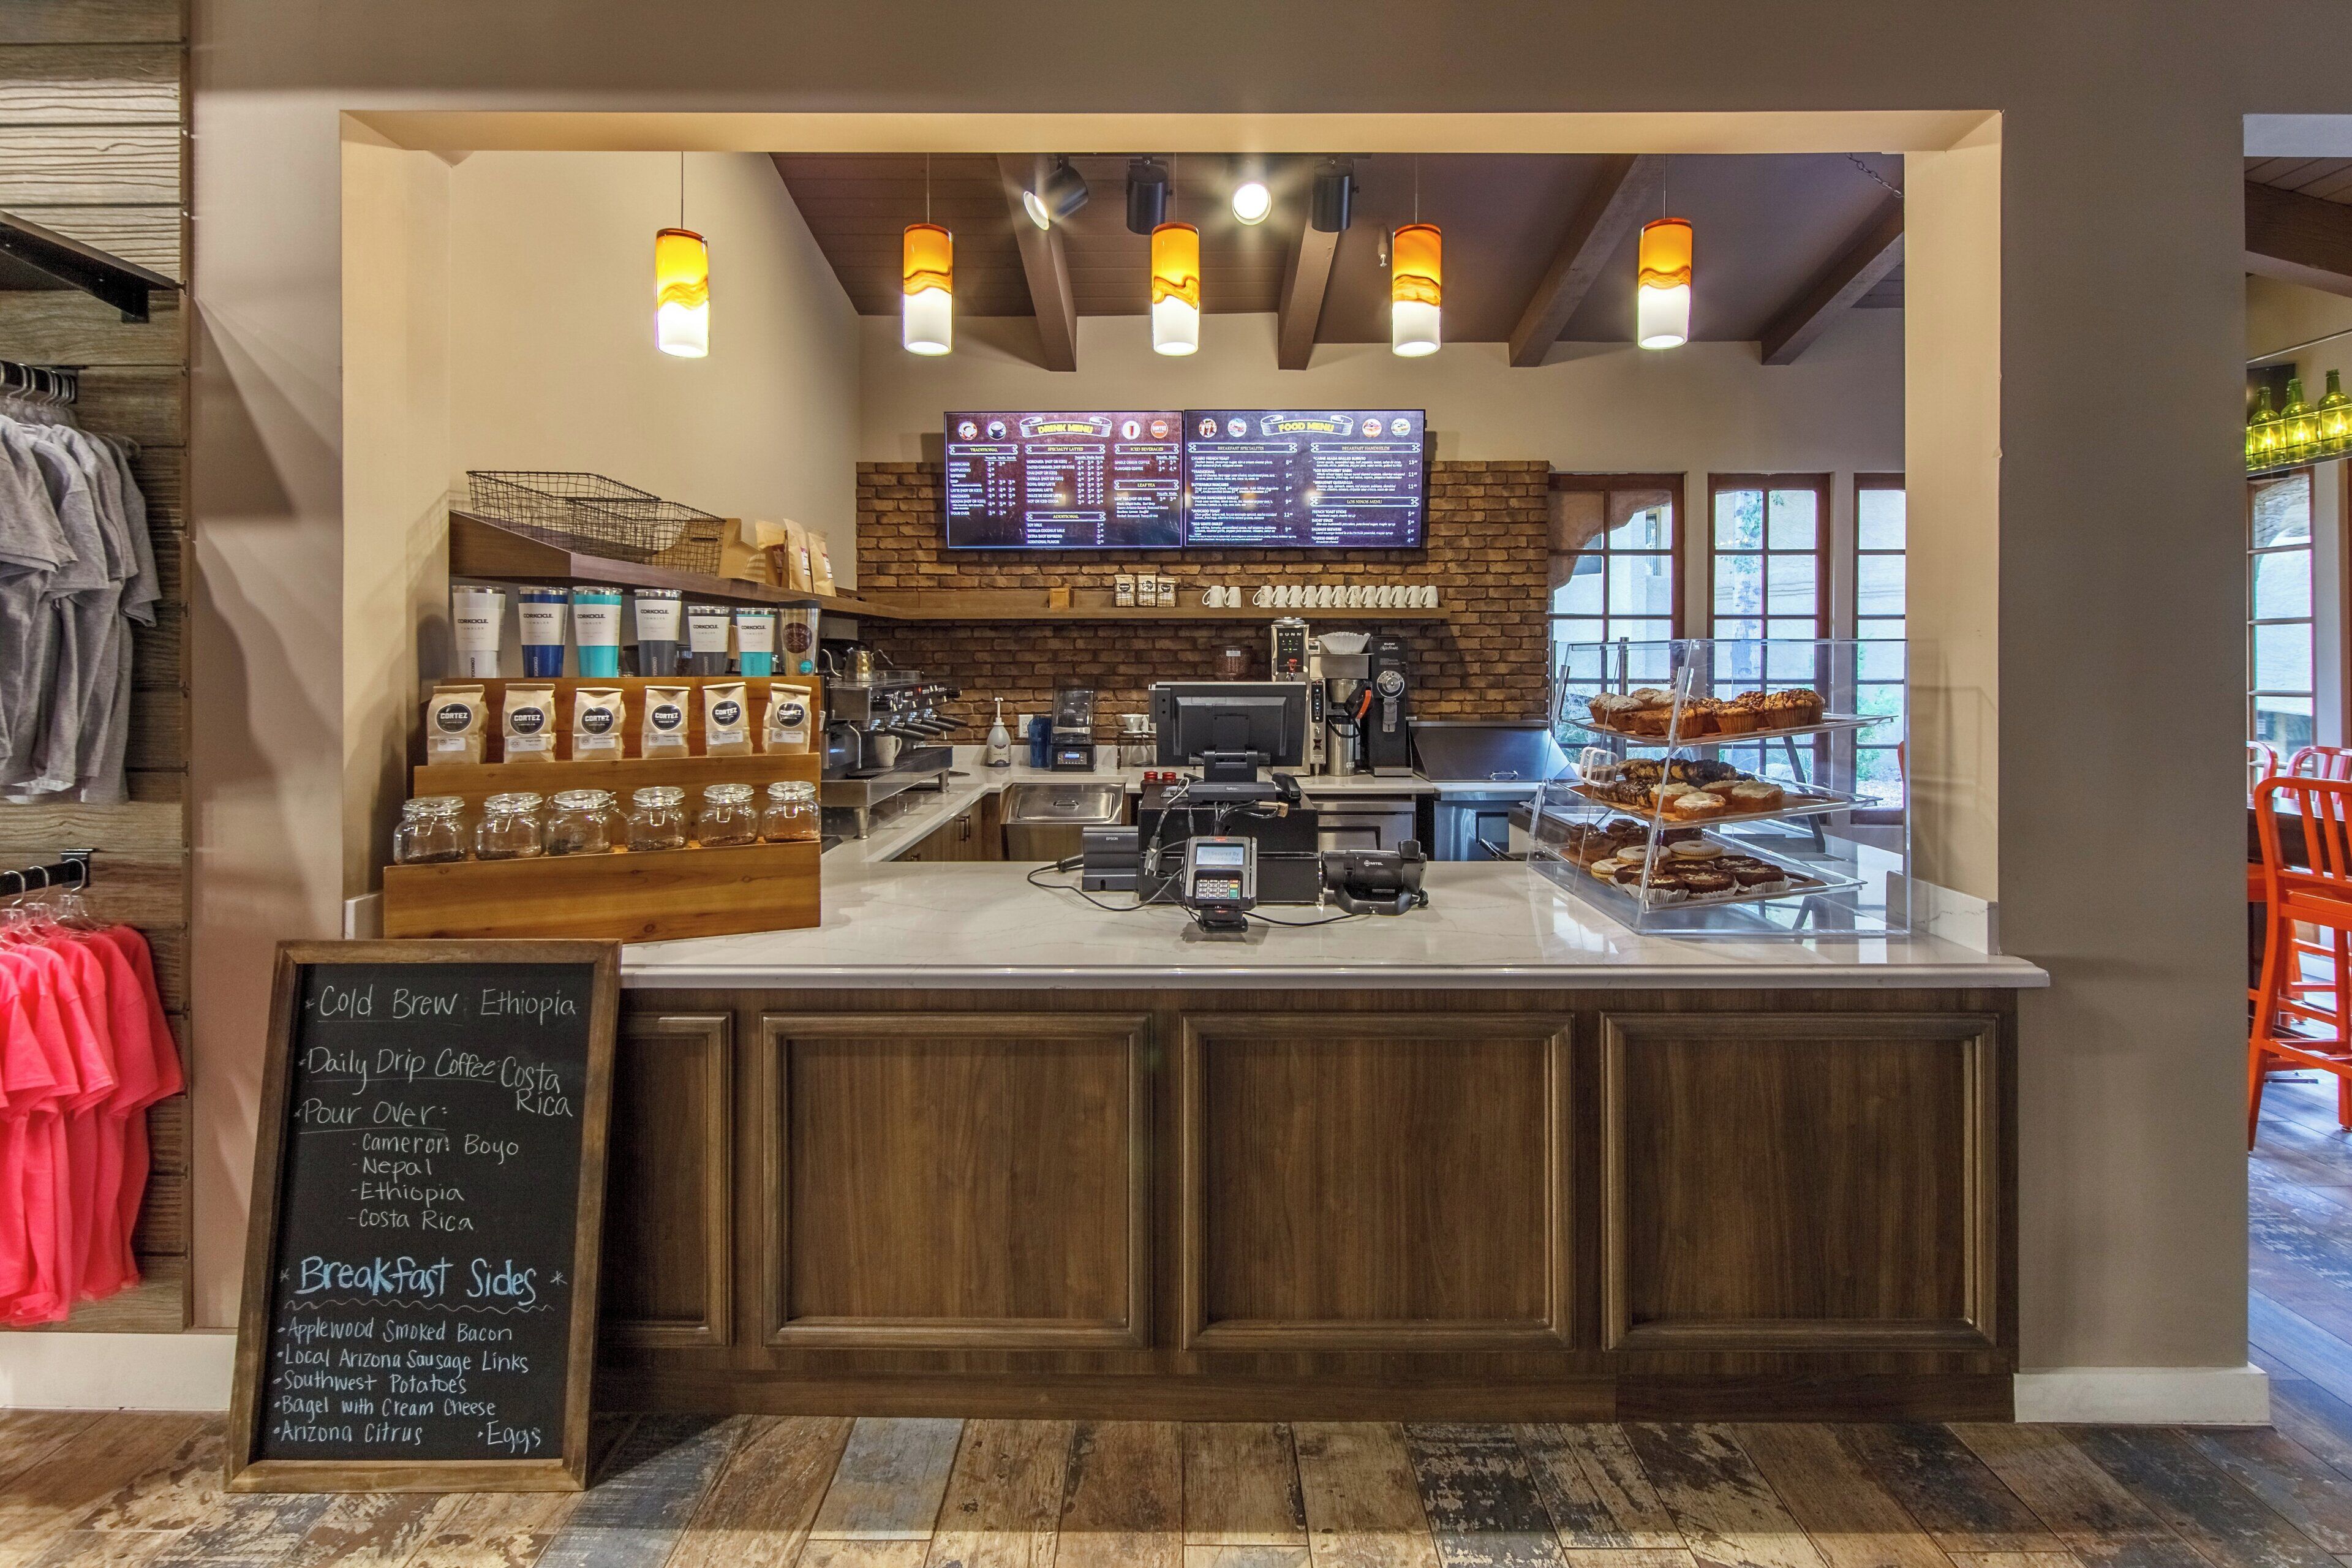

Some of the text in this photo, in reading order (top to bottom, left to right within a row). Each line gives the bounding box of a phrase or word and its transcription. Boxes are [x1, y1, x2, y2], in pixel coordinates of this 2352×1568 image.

[1038, 424, 1093, 434] DRINK MENU
[1278, 422, 1335, 432] FOOD MENU
[320, 984, 576, 1025] Cold Brew Ethiopia
[307, 1047, 367, 1095] Daily
[377, 1049, 425, 1083] Drip
[500, 1057, 560, 1093] Costa
[303, 1098, 361, 1124] Pour
[516, 1089, 573, 1117] Rica
[464, 1134, 519, 1165] Boyo
[363, 1157, 432, 1183] Nepal
[361, 1182, 464, 1207] Ethiopia
[360, 1209, 473, 1231] Costa Rica
[295, 1256, 537, 1306] Breakfast Sides
[288, 1317, 512, 1344] Applewood Smoked Bacon
[285, 1345, 529, 1378] Local Arizona Sausage Links
[284, 1370, 467, 1393] Southwest Potatoes
[282, 1395, 496, 1423] Bagel with Cream Cheese
[281, 1420, 541, 1453] Arizona Citrus Eggs
